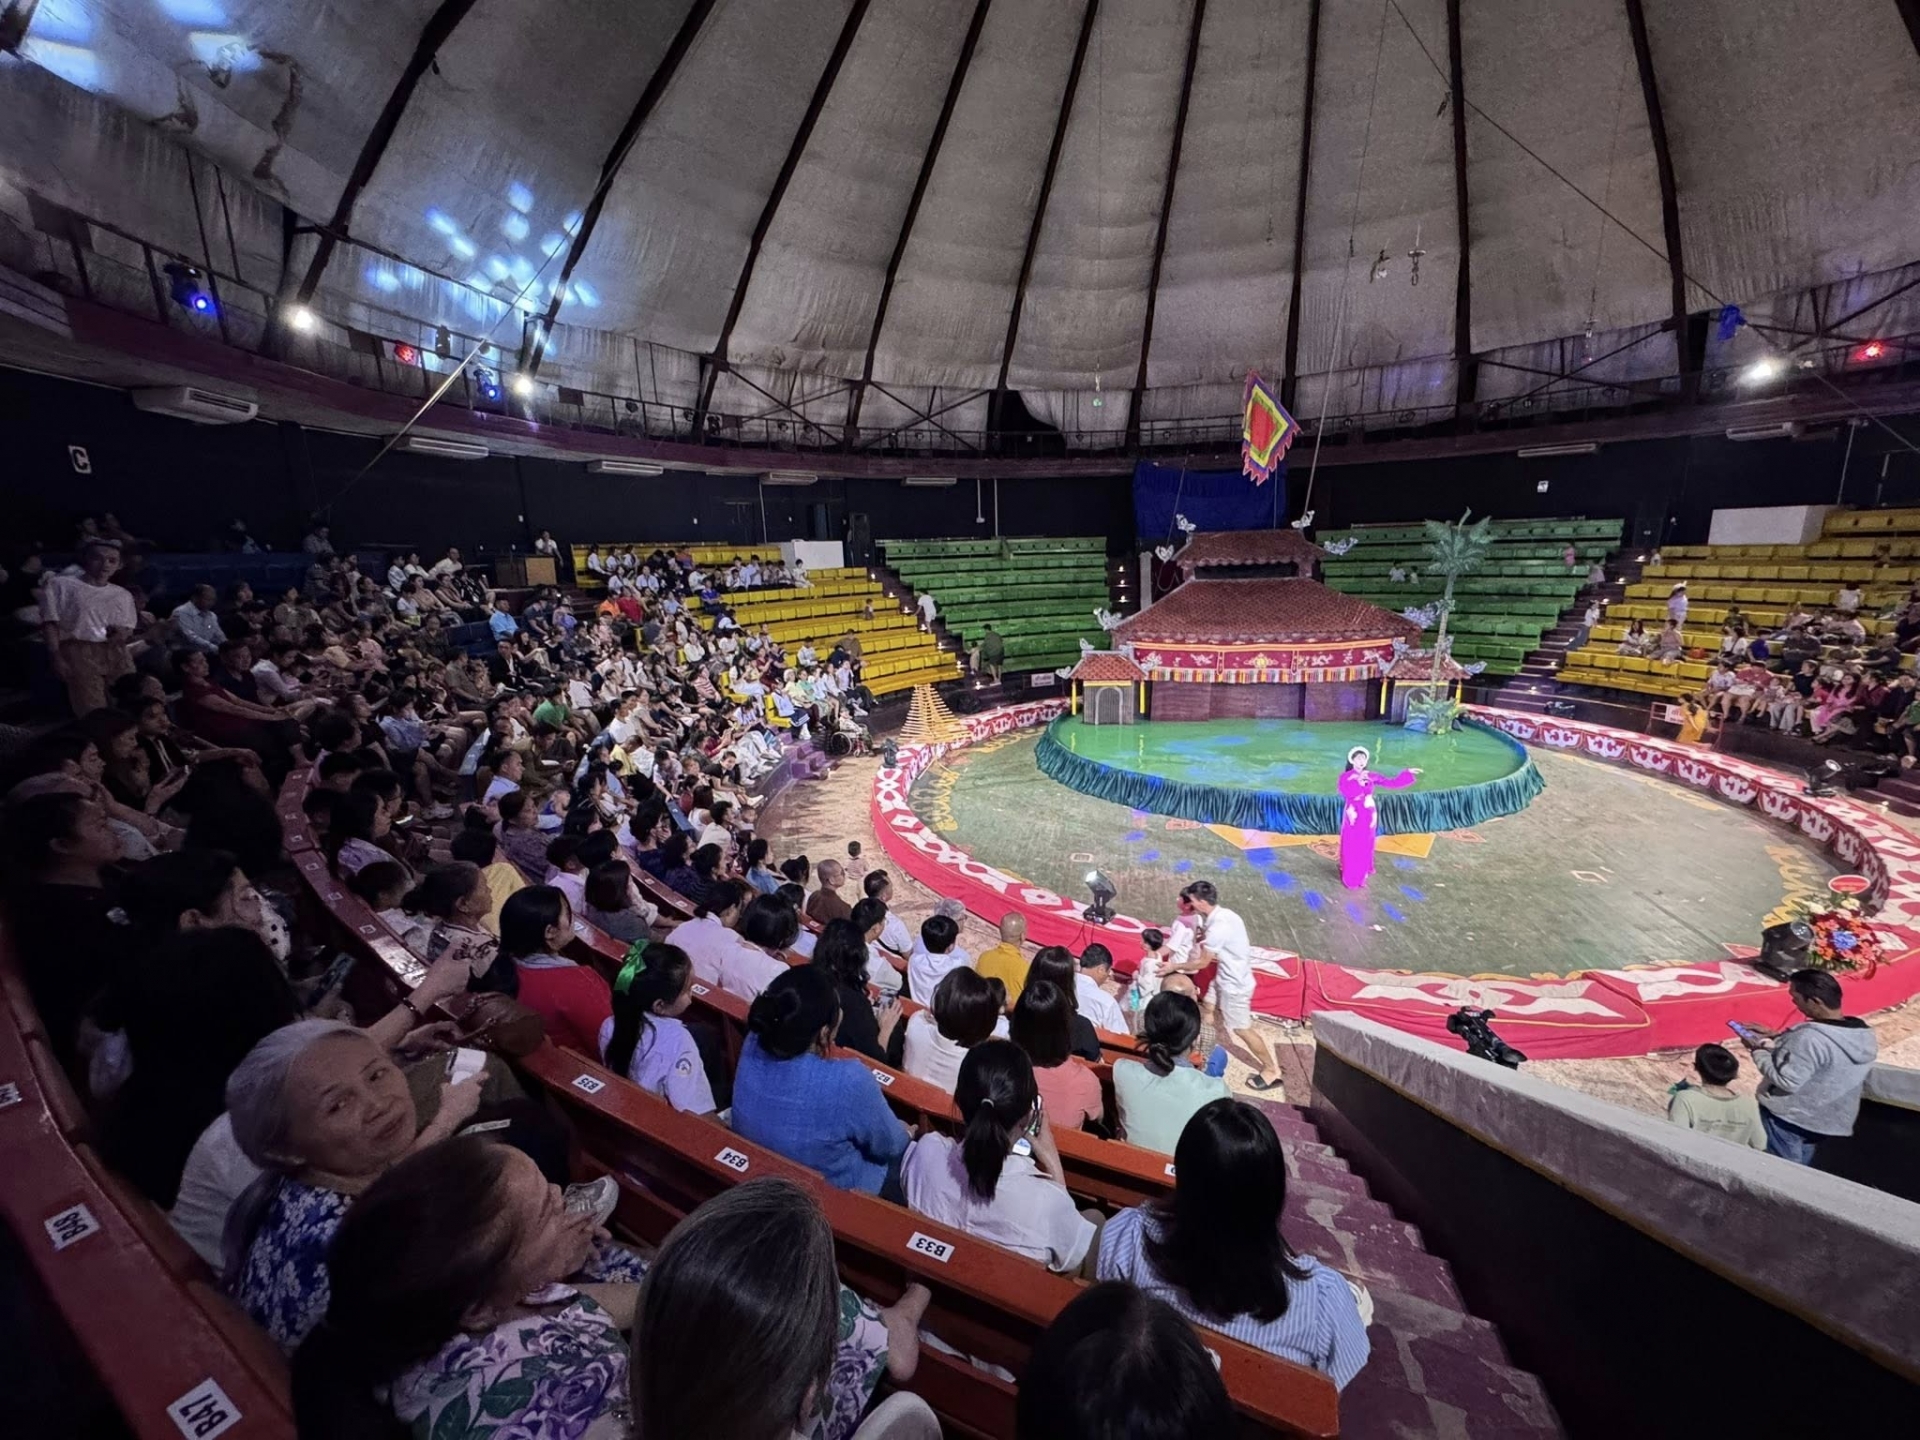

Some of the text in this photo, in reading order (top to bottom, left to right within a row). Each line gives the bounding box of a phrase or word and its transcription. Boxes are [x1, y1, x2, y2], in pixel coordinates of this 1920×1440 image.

[577, 1077, 599, 1090] B35
[722, 1151, 747, 1168] B34
[53, 1212, 89, 1242] B48
[915, 1237, 946, 1257] B33
[179, 1393, 228, 1438] B47
